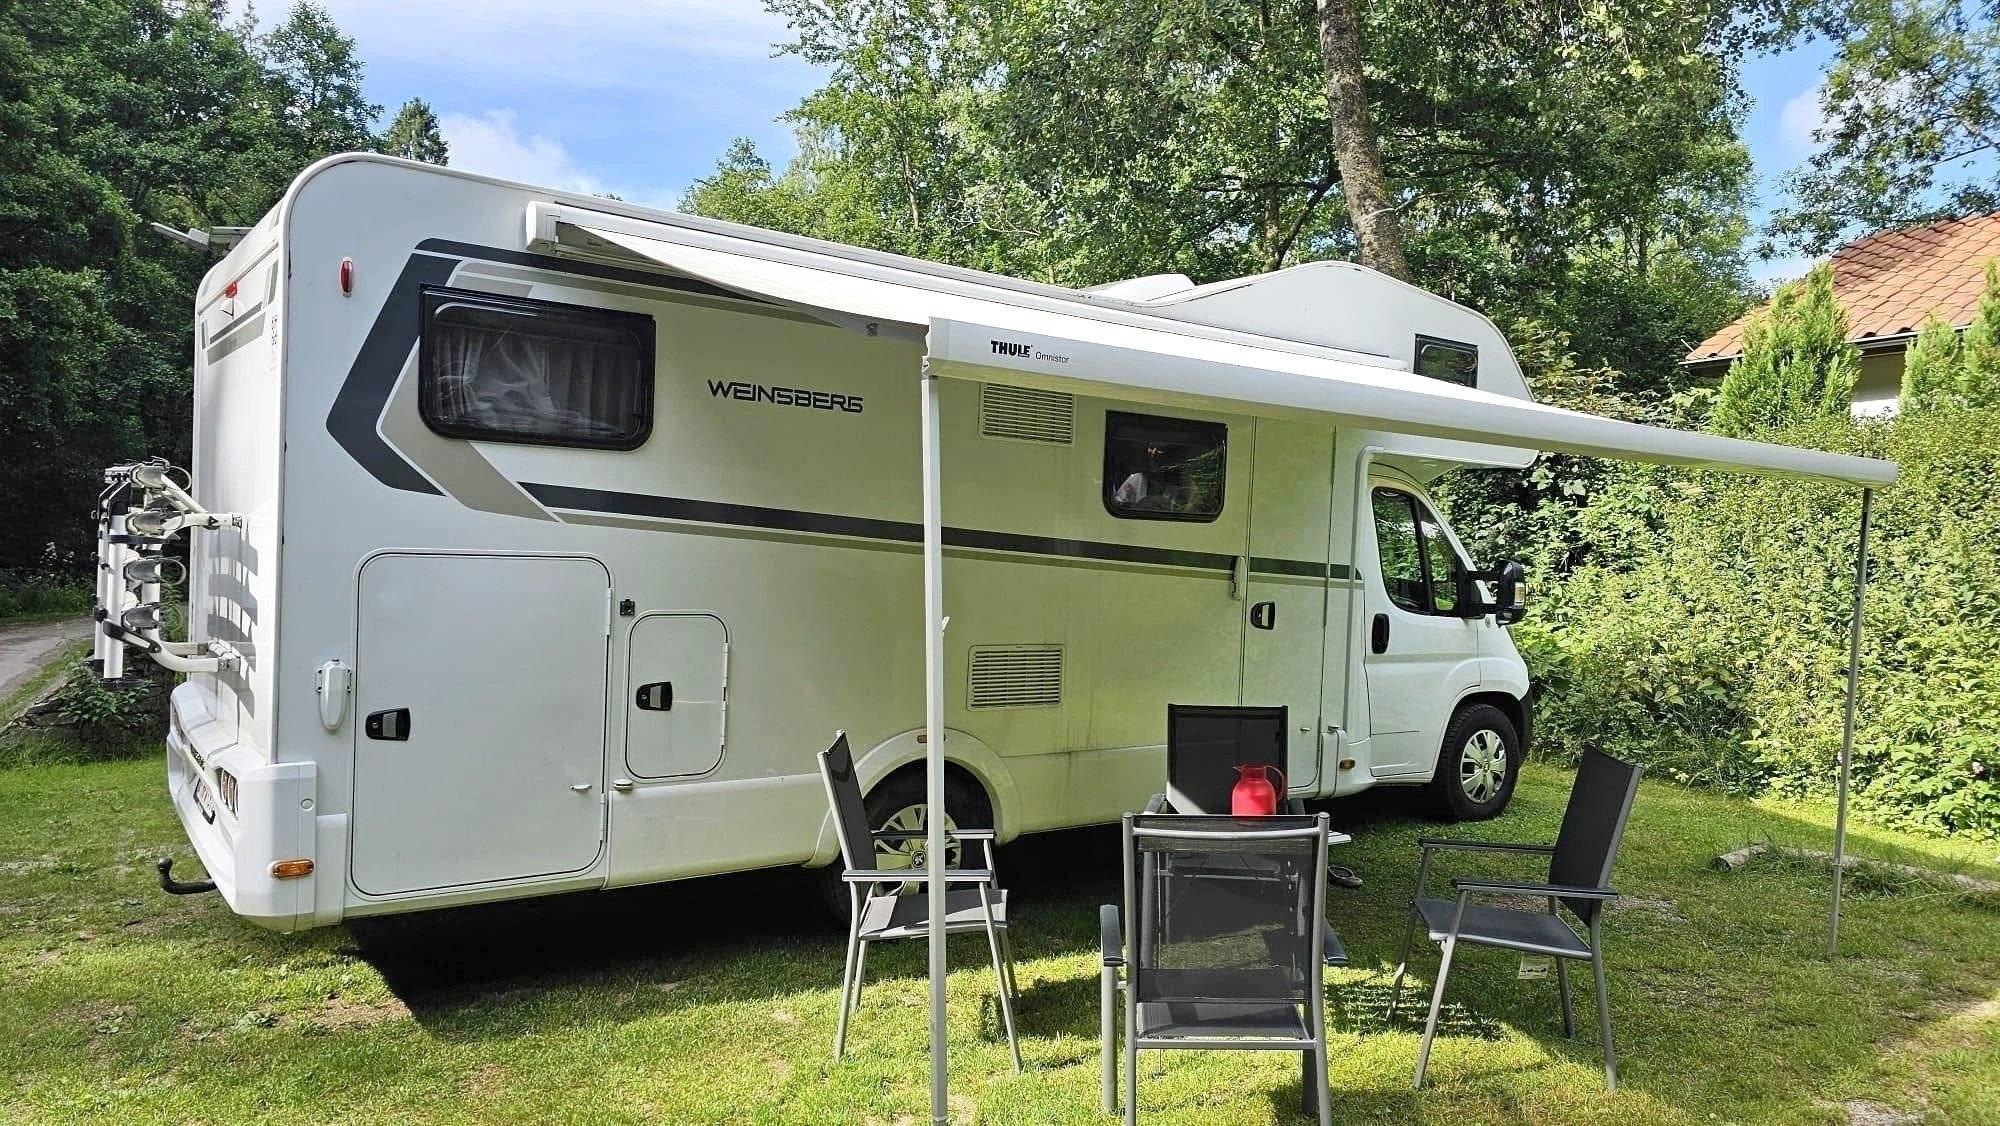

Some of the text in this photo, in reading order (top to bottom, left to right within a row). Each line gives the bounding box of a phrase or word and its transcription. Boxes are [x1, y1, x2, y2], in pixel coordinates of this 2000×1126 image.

[990, 340, 1069, 364] THULE Omnistor
[707, 379, 863, 413] WEINSBERG
